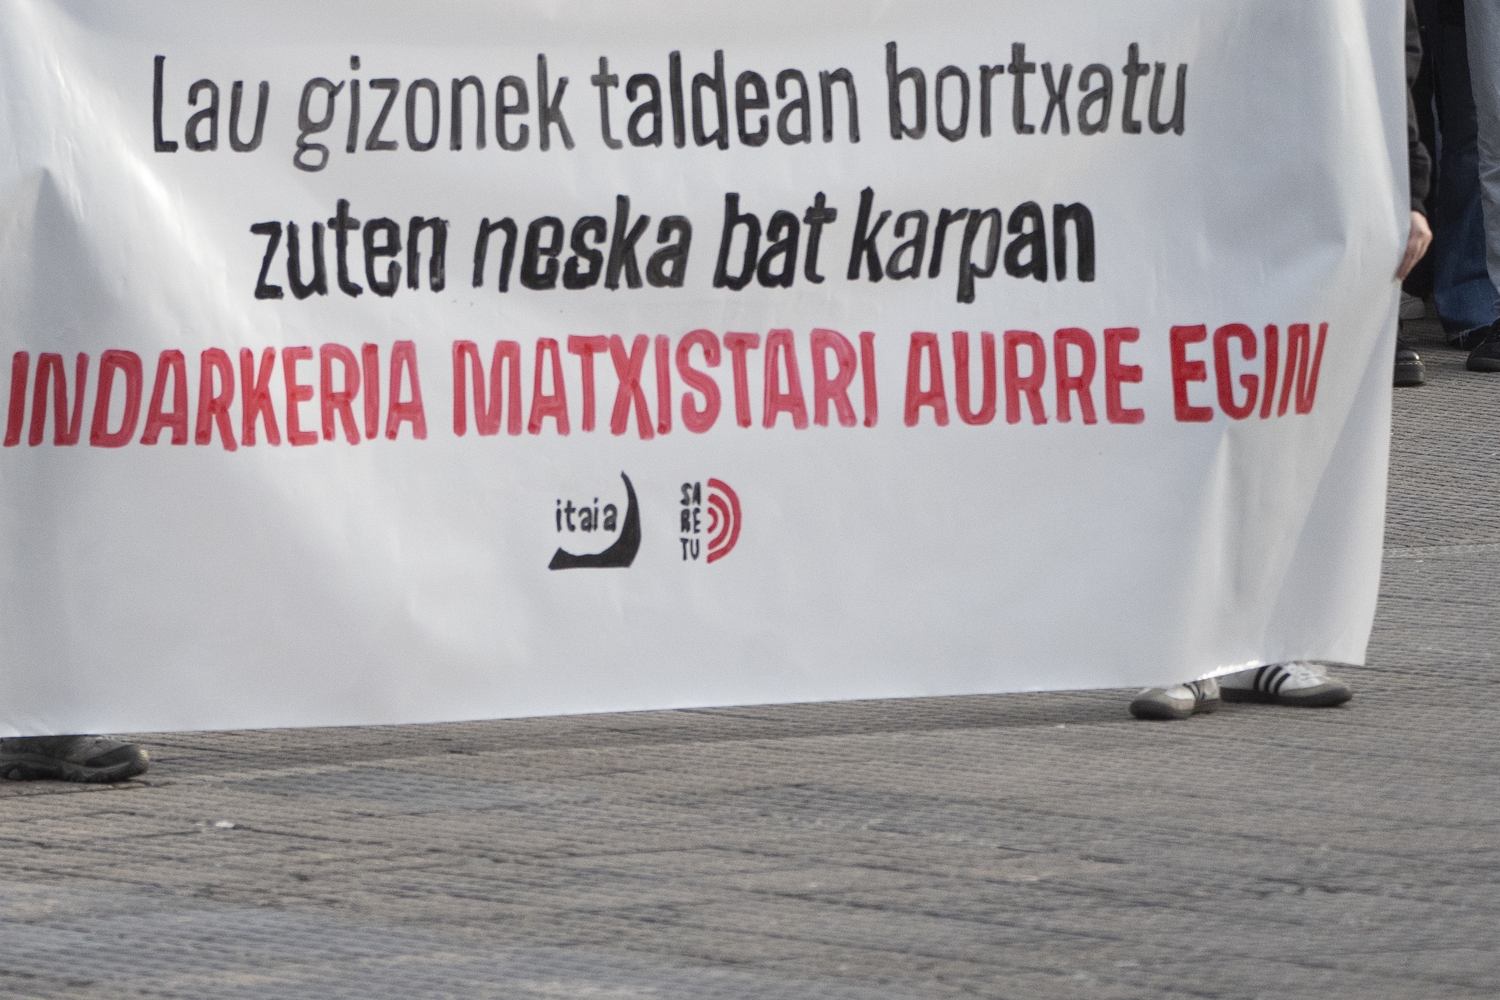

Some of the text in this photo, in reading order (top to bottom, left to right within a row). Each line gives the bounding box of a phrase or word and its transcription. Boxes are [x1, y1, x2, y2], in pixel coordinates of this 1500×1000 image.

[151, 40, 1188, 173] Lau gizonek taldean bortxatu
[249, 185, 1096, 305] zuten neska bat karpan
[3, 322, 1329, 453] INDARKERIA MATXISTARI AURRE EGIN
[555, 497, 619, 534] itaia
